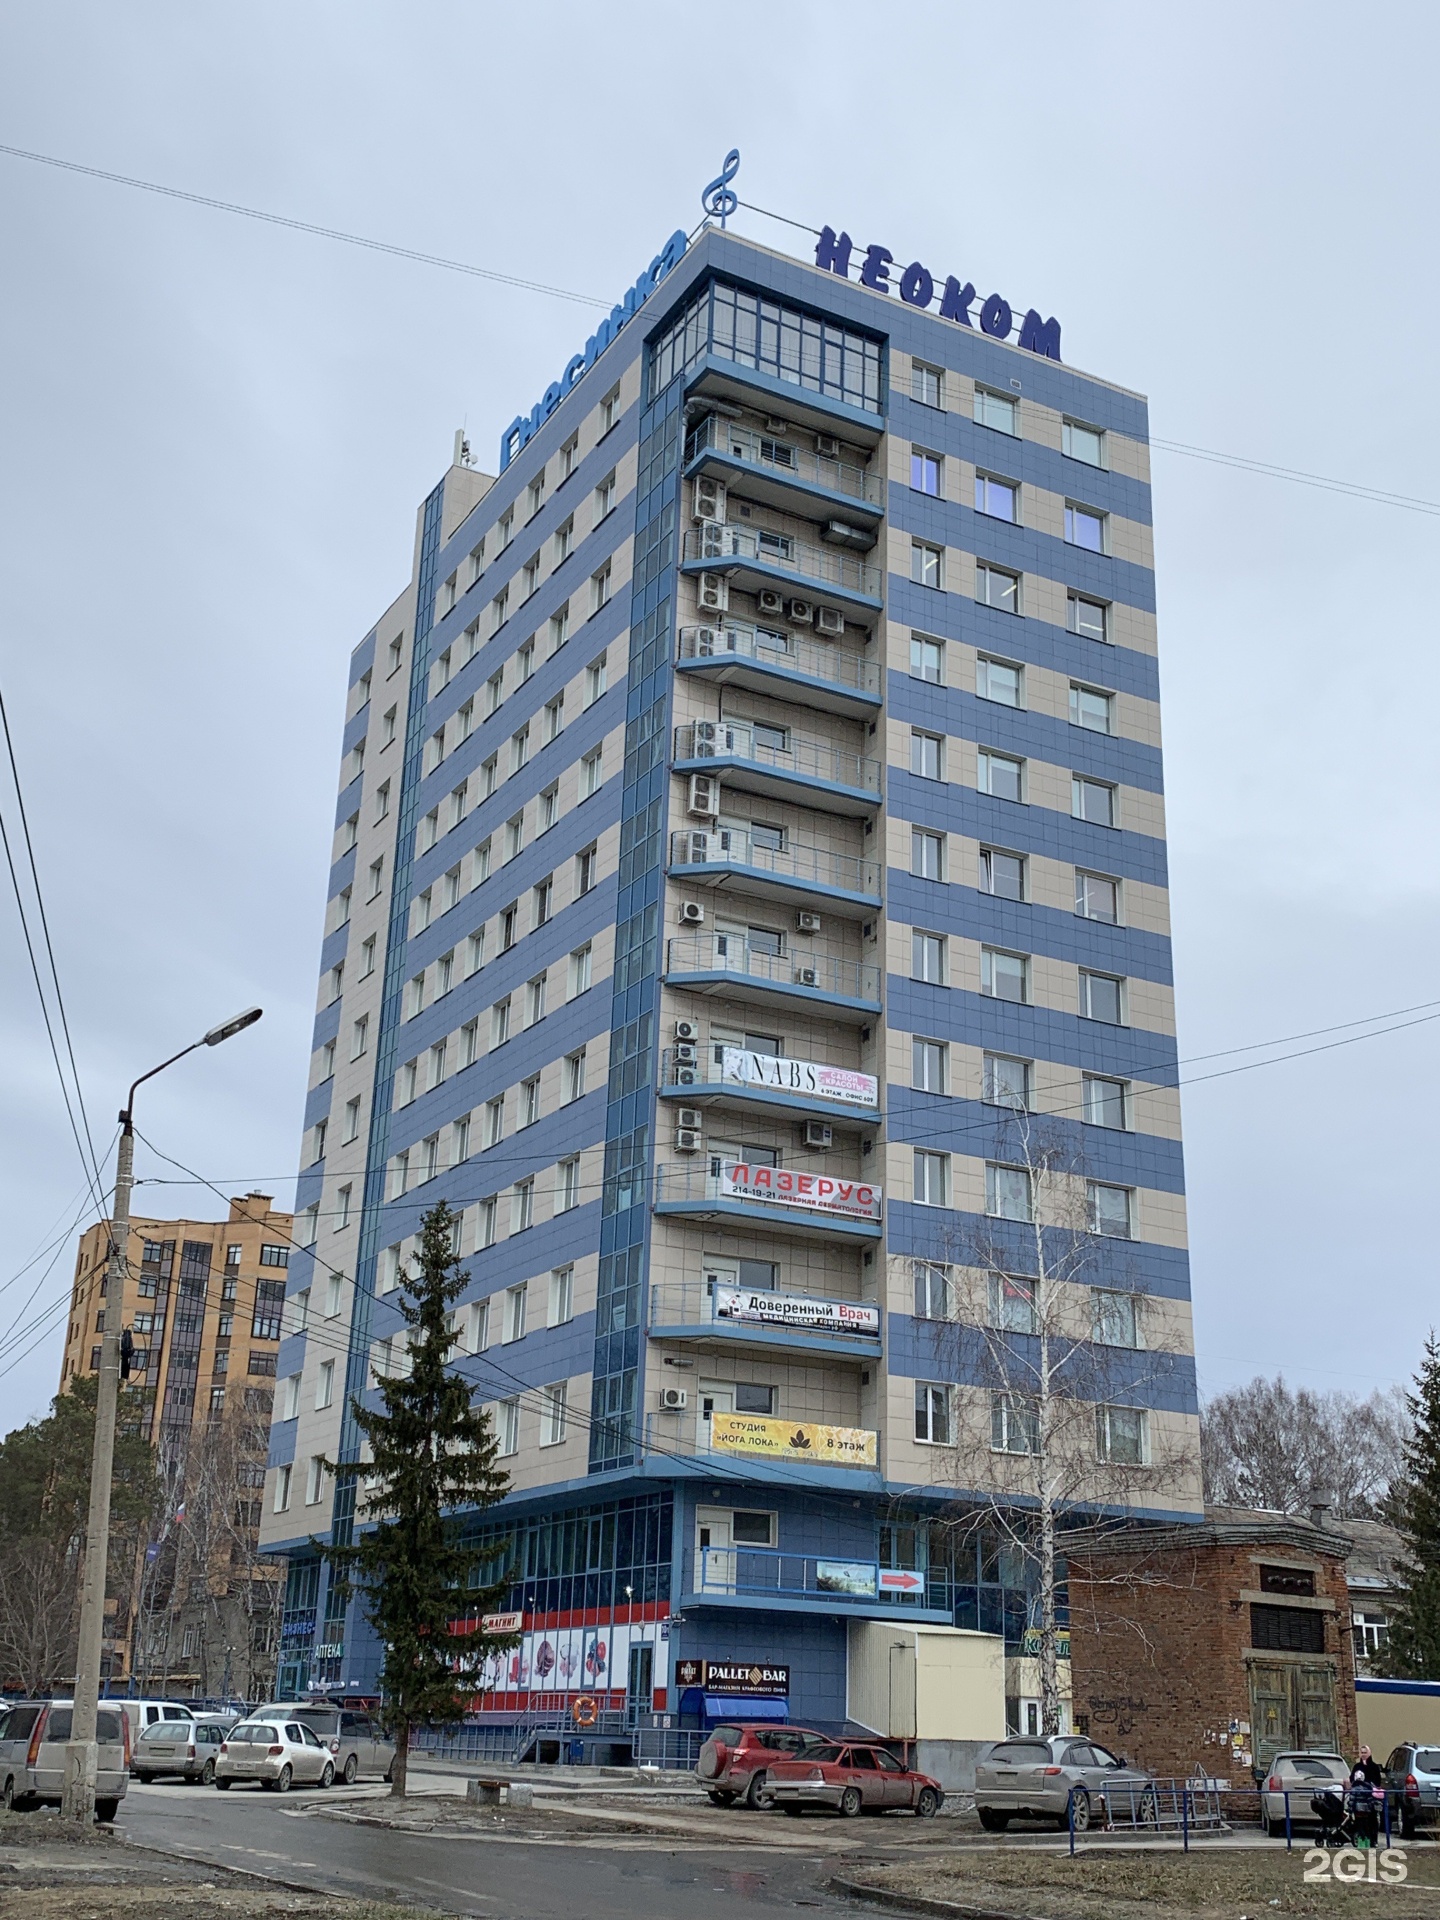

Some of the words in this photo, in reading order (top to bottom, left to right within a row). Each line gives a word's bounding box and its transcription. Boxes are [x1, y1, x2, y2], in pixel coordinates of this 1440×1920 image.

[815, 225, 1062, 362] НЕОКОМ
[751, 1055, 816, 1091] NABS
[830, 1072, 858, 1083] САЛОН
[825, 1078, 864, 1091] КРАСОТЫ
[826, 1089, 842, 1097] ЭТАЖ
[845, 1092, 863, 1101] ОФИС
[732, 1165, 873, 1205] ЛАЗЕРУС
[732, 1186, 776, 1199] 214-19-21
[778, 1194, 817, 1206] ЛАЗЕРНАЯ
[818, 1201, 873, 1216] ДЕРМАТОЛОГИЯ
[749, 1296, 833, 1316] Доверенный
[838, 1304, 871, 1321] Врач
[762, 1313, 818, 1324] МЕДИЦИНСКАЯ
[819, 1319, 857, 1328] КОМПАНИЯ
[729, 1421, 766, 1433] СТУДИЯ
[826, 1438, 834, 1448] 8
[837, 1441, 865, 1452] этаж
[488, 1617, 516, 1628] МАГНИТ
[314, 1642, 342, 1659] АПТЕКА
[708, 1666, 751, 1680] PALLET
[762, 1669, 787, 1682] BAR
